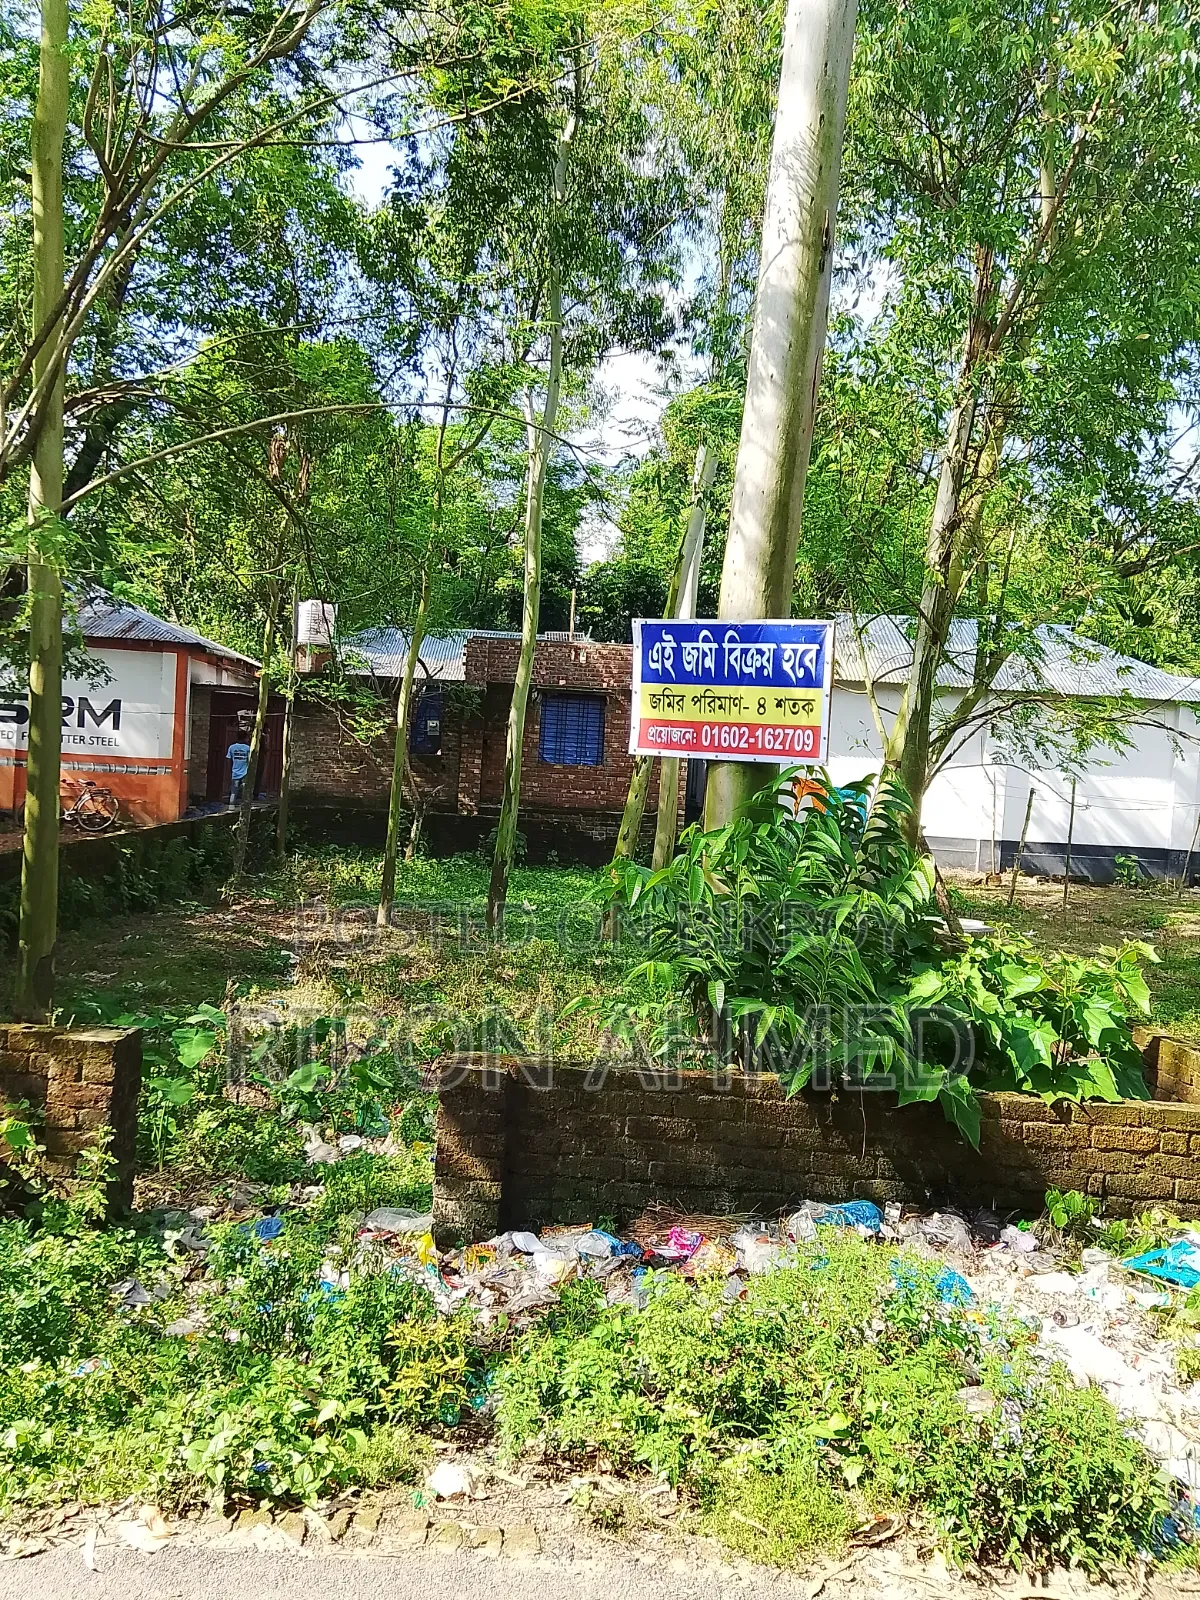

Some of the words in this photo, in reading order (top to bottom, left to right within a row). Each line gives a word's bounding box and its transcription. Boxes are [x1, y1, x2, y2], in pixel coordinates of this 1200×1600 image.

[649, 631, 677, 680] এই
[682, 630, 718, 678] জমি
[723, 630, 777, 679] বিক্রয়
[781, 643, 820, 685] হবে
[648, 687, 686, 714] জমির
[757, 697, 767, 715] ৪
[774, 697, 816, 718] শতক
[88, 735, 120, 746] STEEL
[701, 724, 814, 752] 01602-162709
